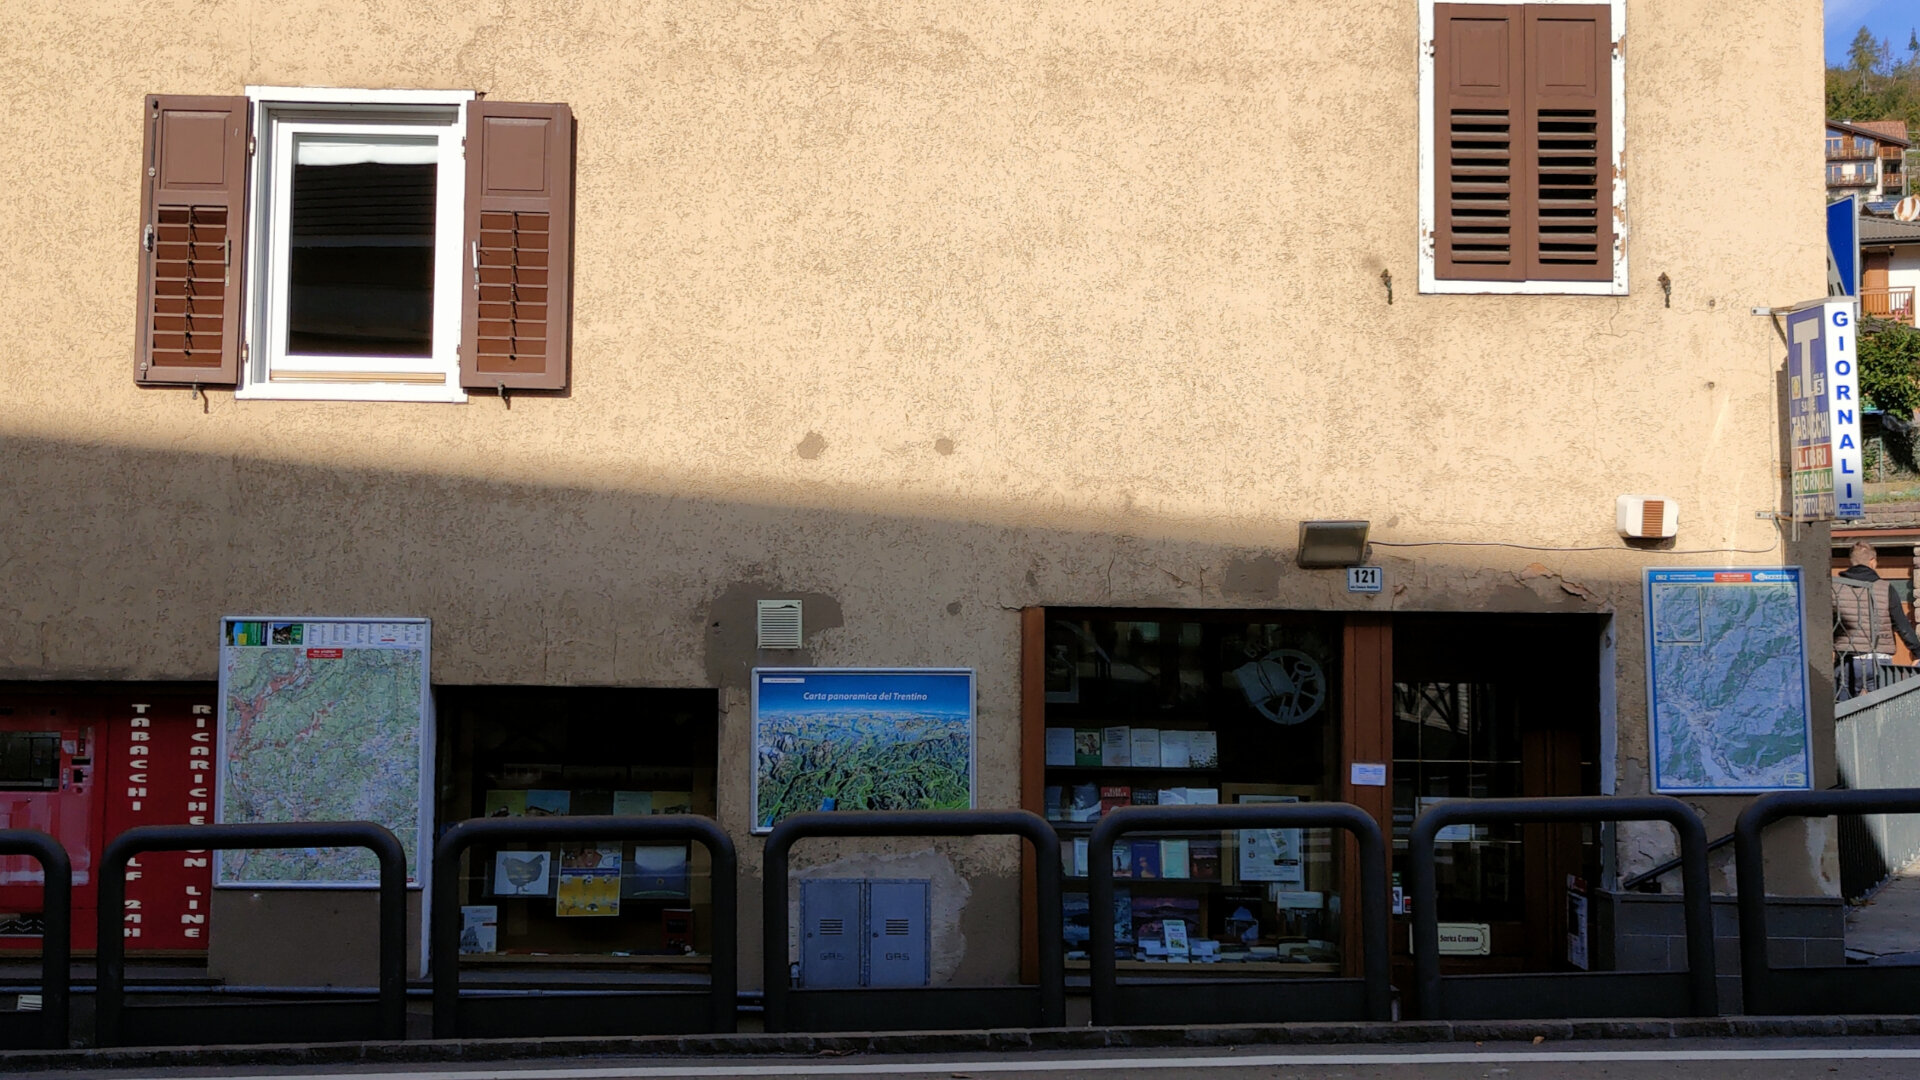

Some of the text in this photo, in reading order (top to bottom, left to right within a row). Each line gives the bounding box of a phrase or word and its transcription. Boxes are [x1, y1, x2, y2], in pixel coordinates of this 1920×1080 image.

[1793, 318, 1819, 398] T
[1816, 382, 1823, 393] 5
[1832, 311, 1855, 499] GIORNALI
[1798, 447, 1827, 467] LIBRI
[1795, 471, 1833, 491] GIORNALI
[1354, 570, 1375, 583] 121
[803, 692, 928, 702] Carta panoramica del Trentino
[127, 704, 151, 811] TABACCHI
[188, 704, 212, 826] RICARICHE
[123, 900, 142, 938] 24H
[181, 885, 205, 938] LINE
